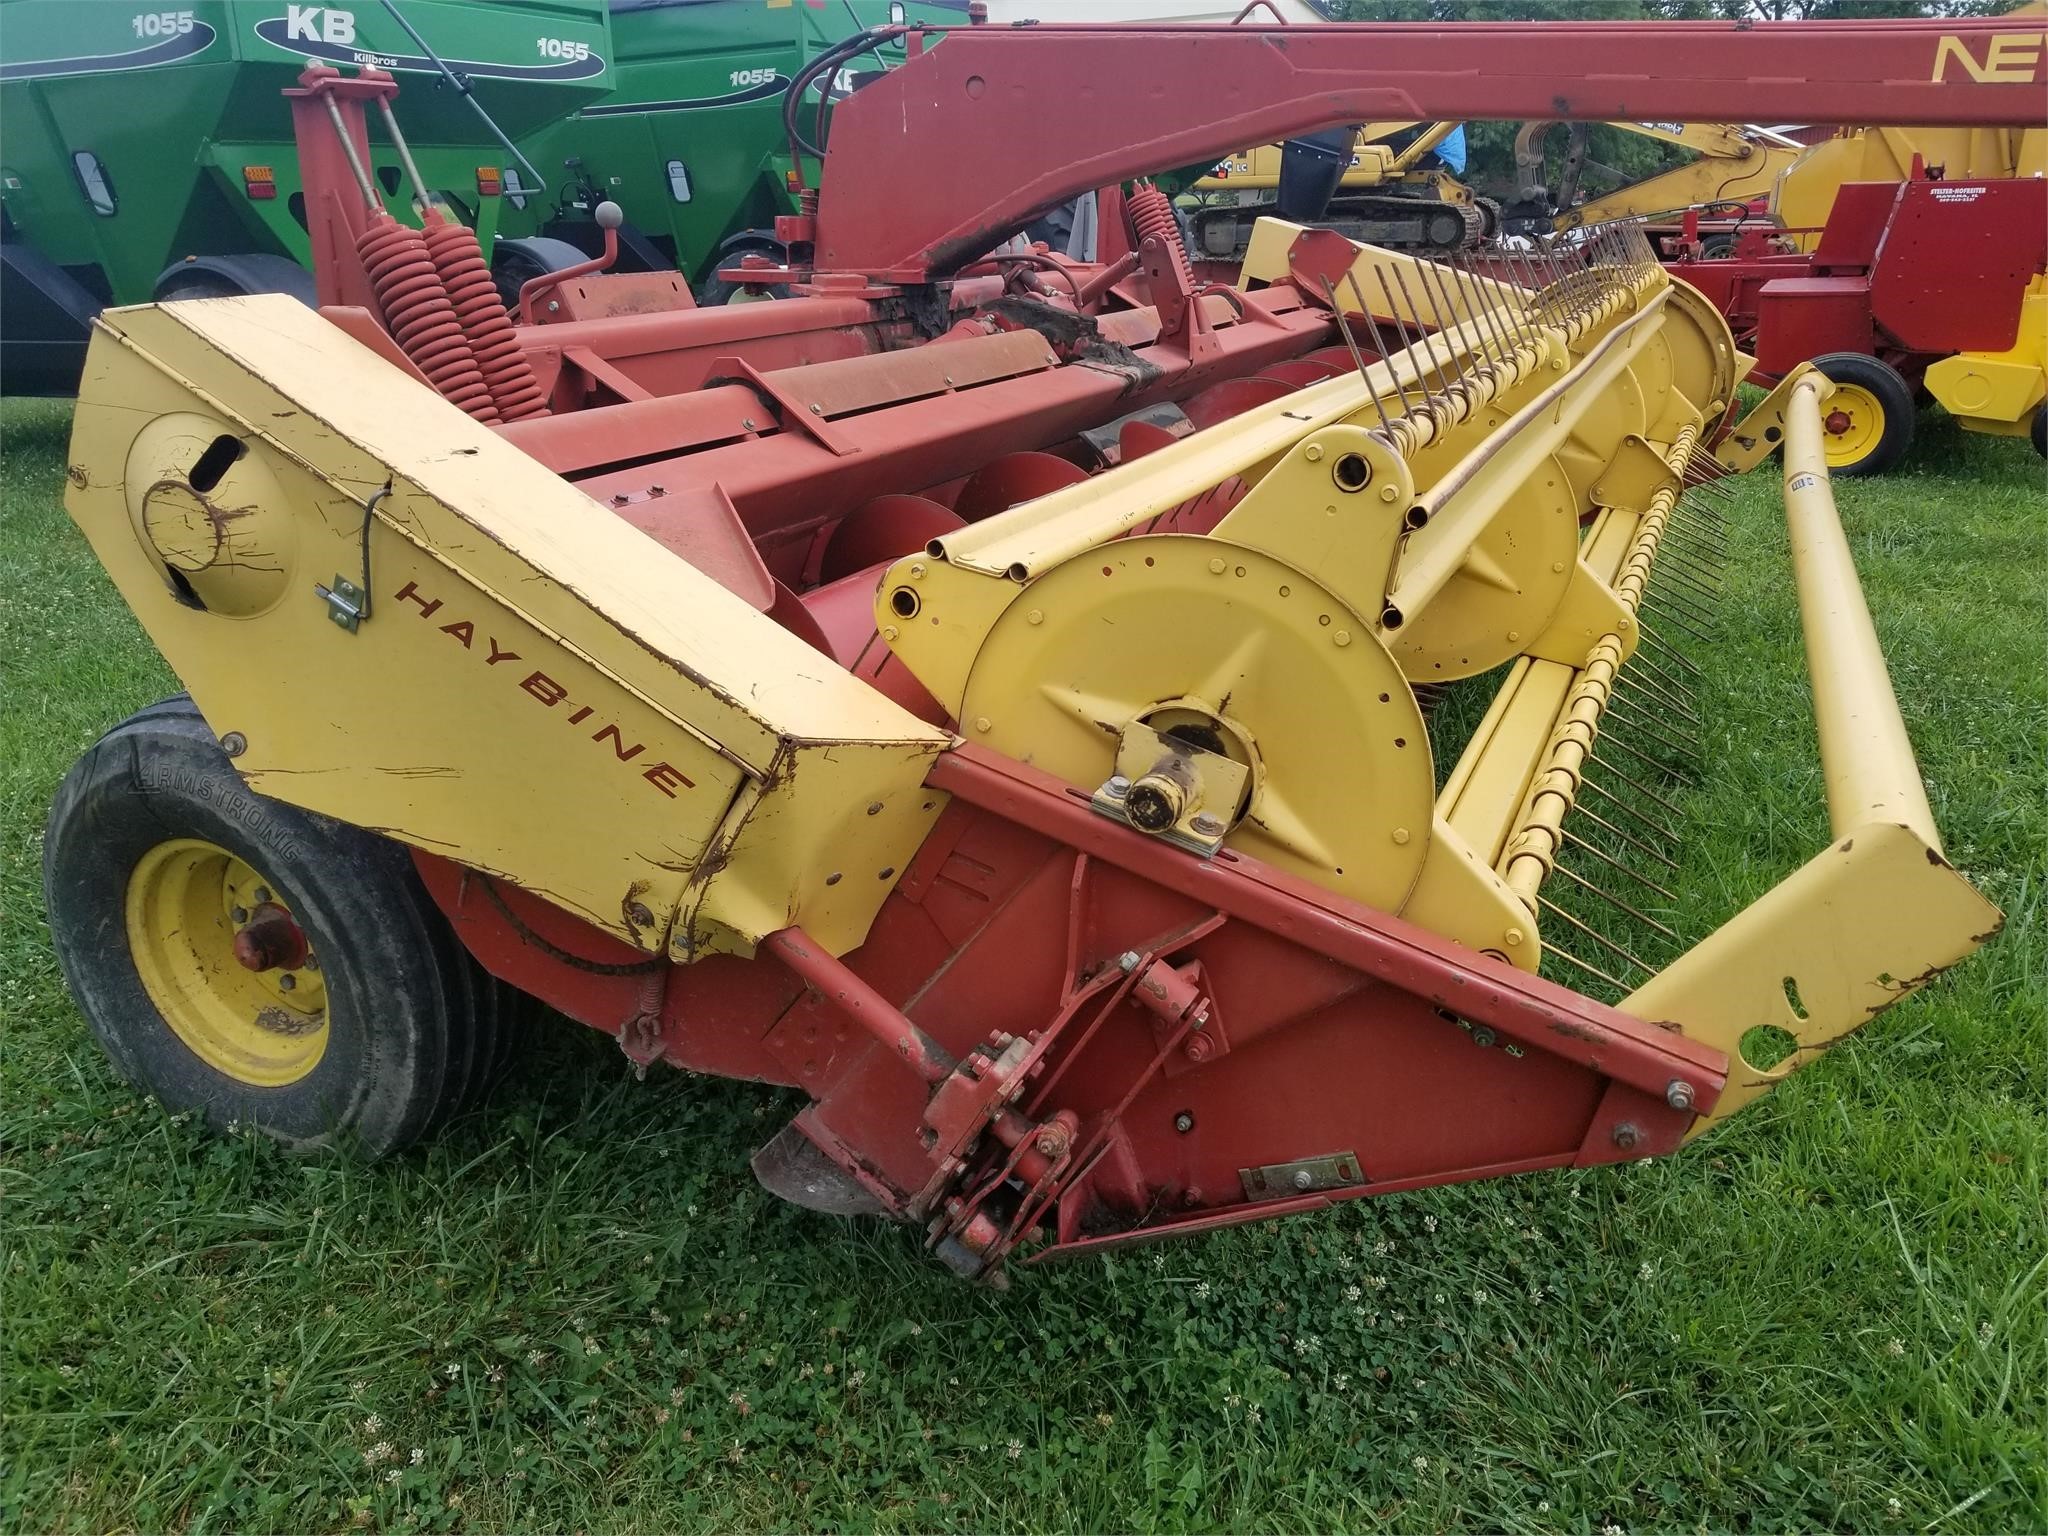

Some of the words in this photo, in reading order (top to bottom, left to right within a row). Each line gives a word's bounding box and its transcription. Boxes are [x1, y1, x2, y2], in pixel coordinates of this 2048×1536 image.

[132, 10, 194, 39] 1055
[287, 4, 356, 44] KB
[353, 52, 397, 67] Killbros
[536, 37, 590, 61] 1055
[1931, 33, 2048, 83] NE
[729, 67, 777, 87] 1055
[394, 581, 696, 800] HAYBINE
[127, 753, 302, 866] ARMSTRONG
